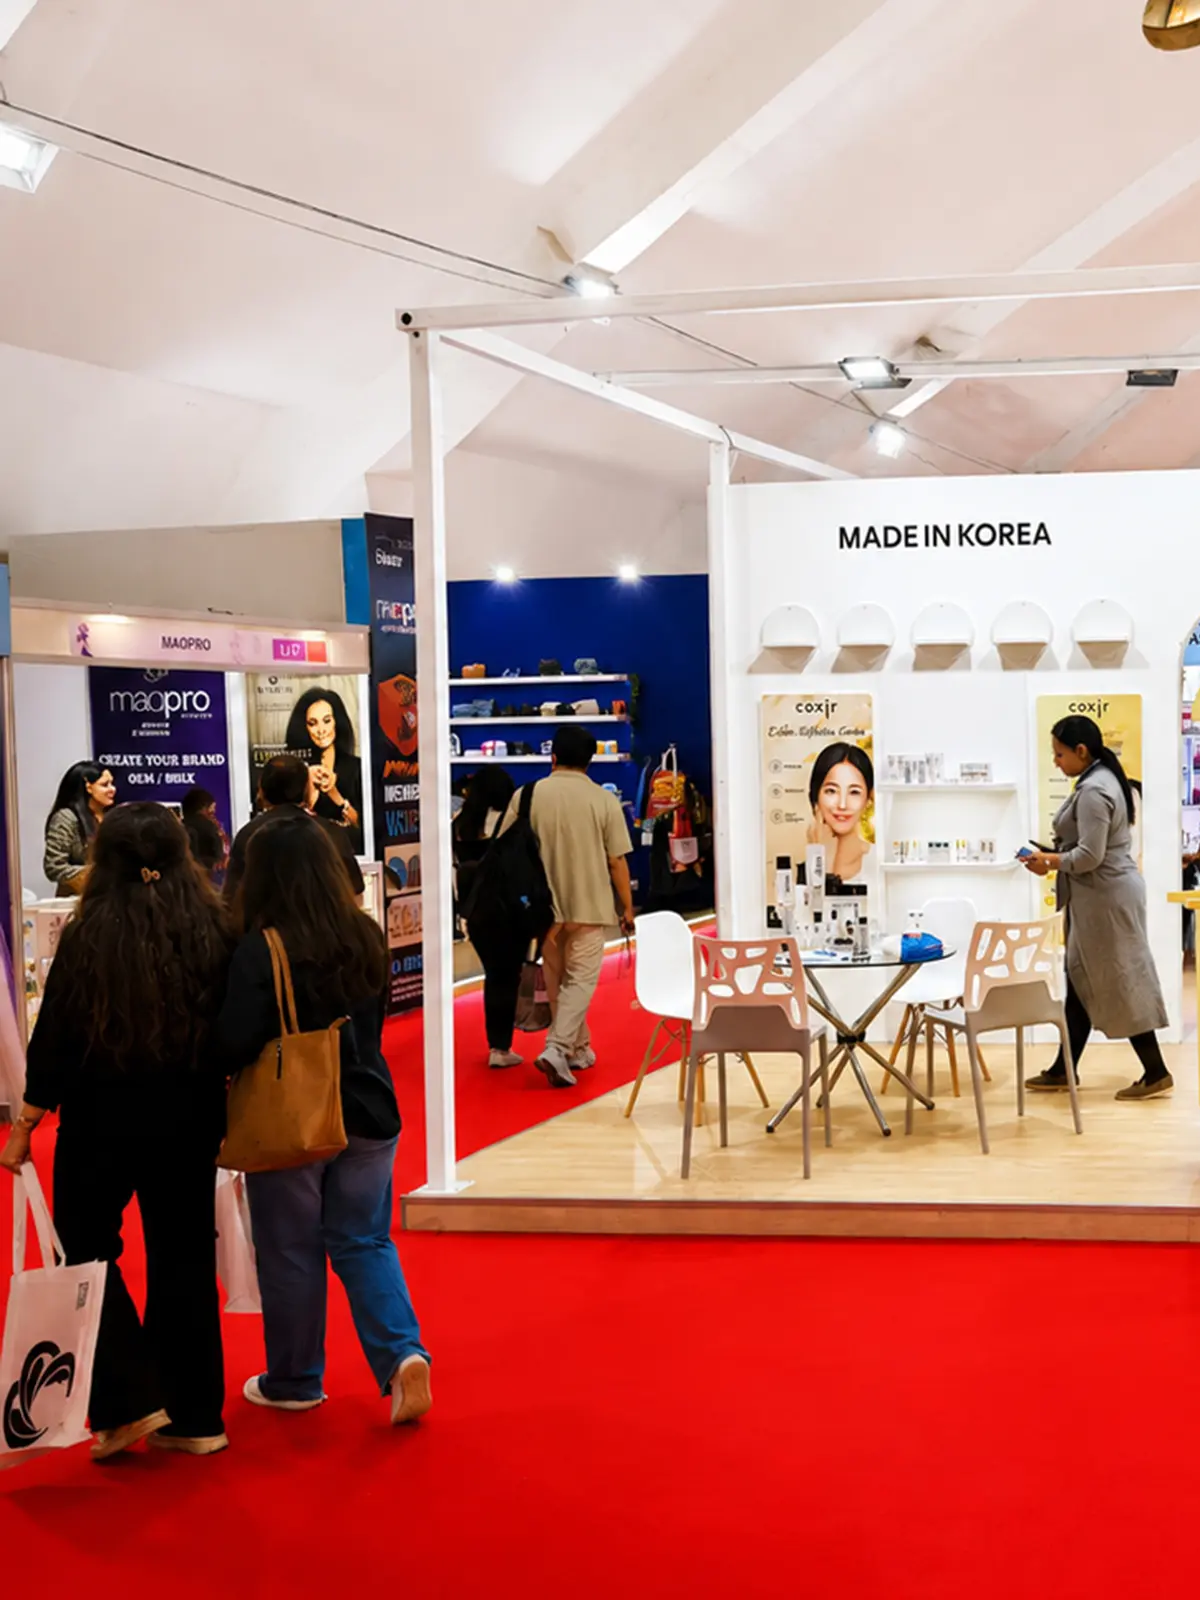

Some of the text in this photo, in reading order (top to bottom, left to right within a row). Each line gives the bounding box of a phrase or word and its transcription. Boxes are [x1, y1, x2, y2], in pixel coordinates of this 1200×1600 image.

[838, 522, 1052, 549] MADE IN KOREA
